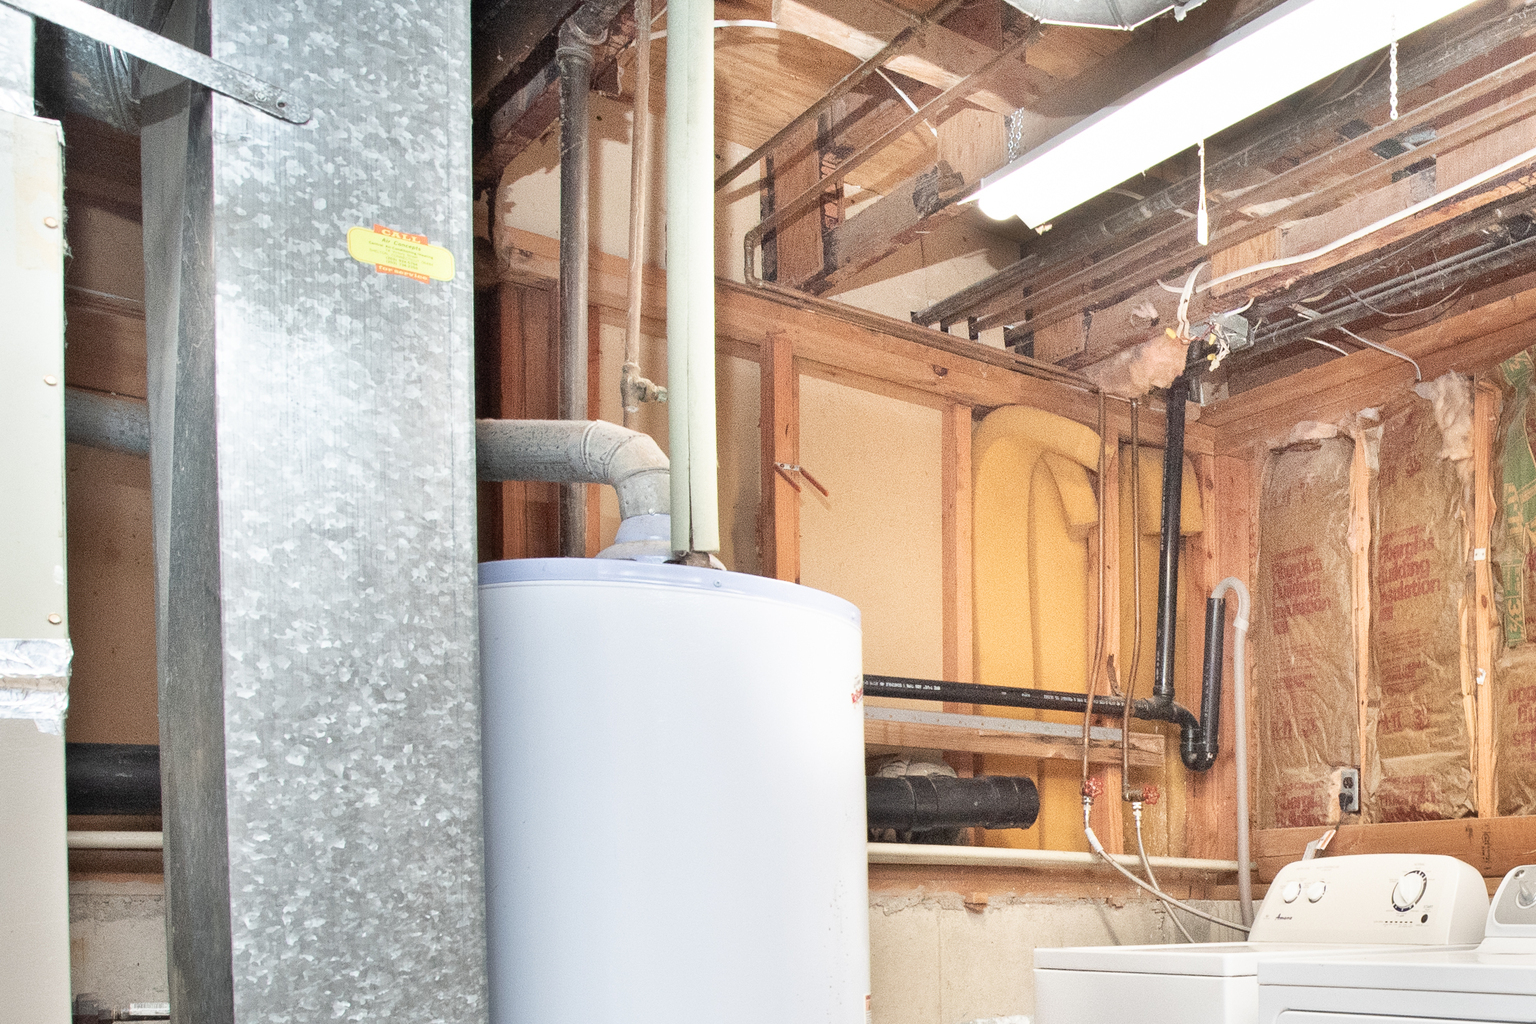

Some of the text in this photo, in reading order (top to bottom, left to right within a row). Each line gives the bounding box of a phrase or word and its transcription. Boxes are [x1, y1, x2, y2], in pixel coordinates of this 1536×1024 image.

[381, 229, 421, 245] CALL
[393, 241, 421, 251] Concepts
[394, 269, 429, 280] service
[1274, 913, 1293, 921] Amana
